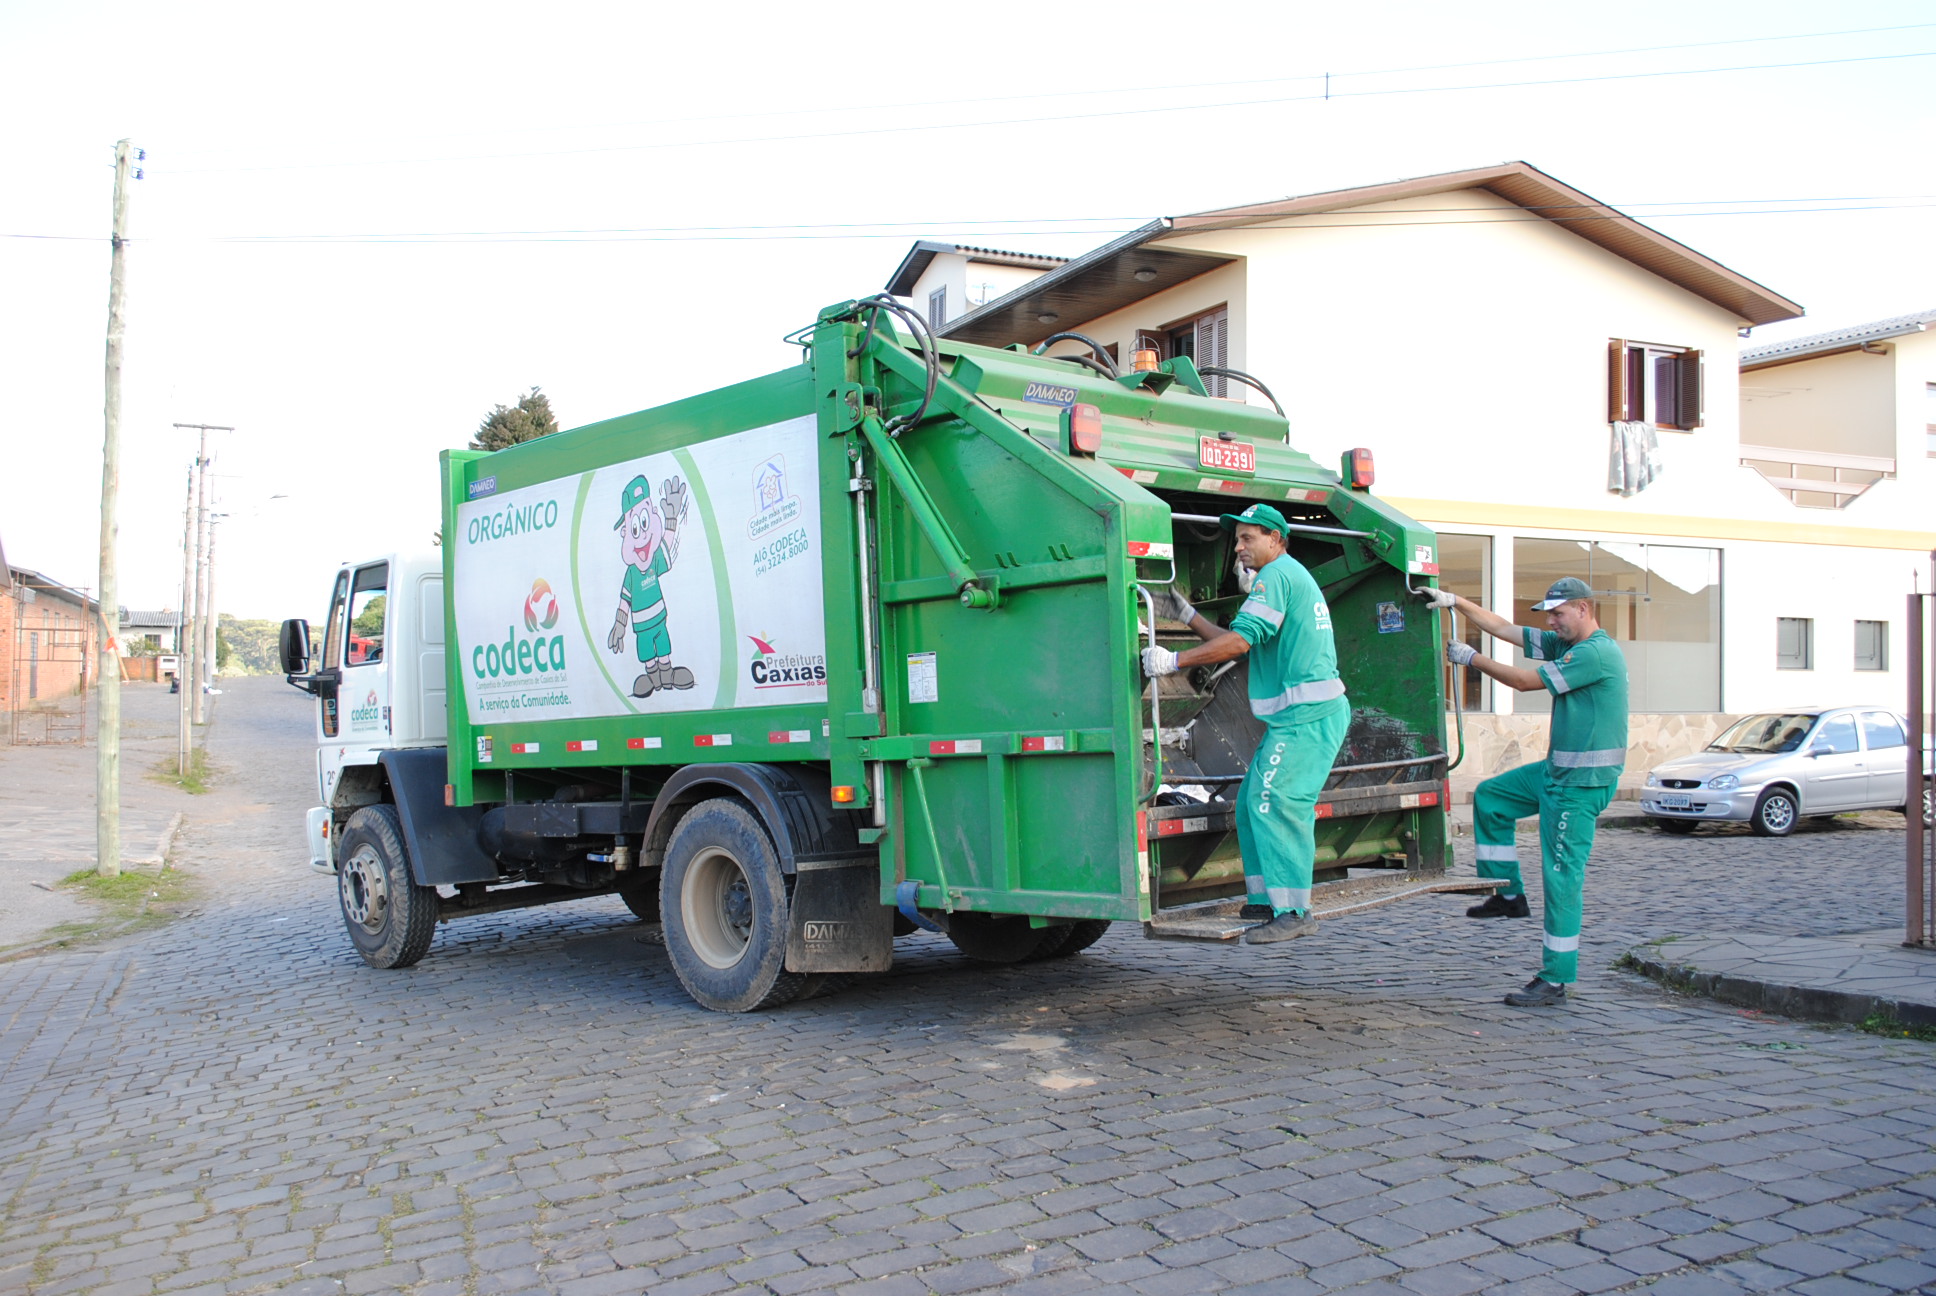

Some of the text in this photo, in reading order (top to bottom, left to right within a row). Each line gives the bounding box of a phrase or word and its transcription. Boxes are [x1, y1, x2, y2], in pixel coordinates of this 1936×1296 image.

[1026, 384, 1074, 403] DAMAEQ
[469, 479, 496, 495] DAMAEQ
[468, 499, 558, 545] ORGÂNICO
[750, 515, 768, 529] Cidade
[768, 509, 780, 519] mais
[752, 523, 769, 536] Cidade
[770, 516, 783, 527] mais
[753, 526, 807, 566] Alô CODECA
[755, 539, 809, 578] (54) 3224.8000
[473, 625, 566, 679] codeca
[765, 654, 824, 669] Prefeitura
[751, 660, 826, 684] Caxias
[351, 704, 378, 721] codeca
[480, 691, 572, 713] A serviço da Comunidade.
